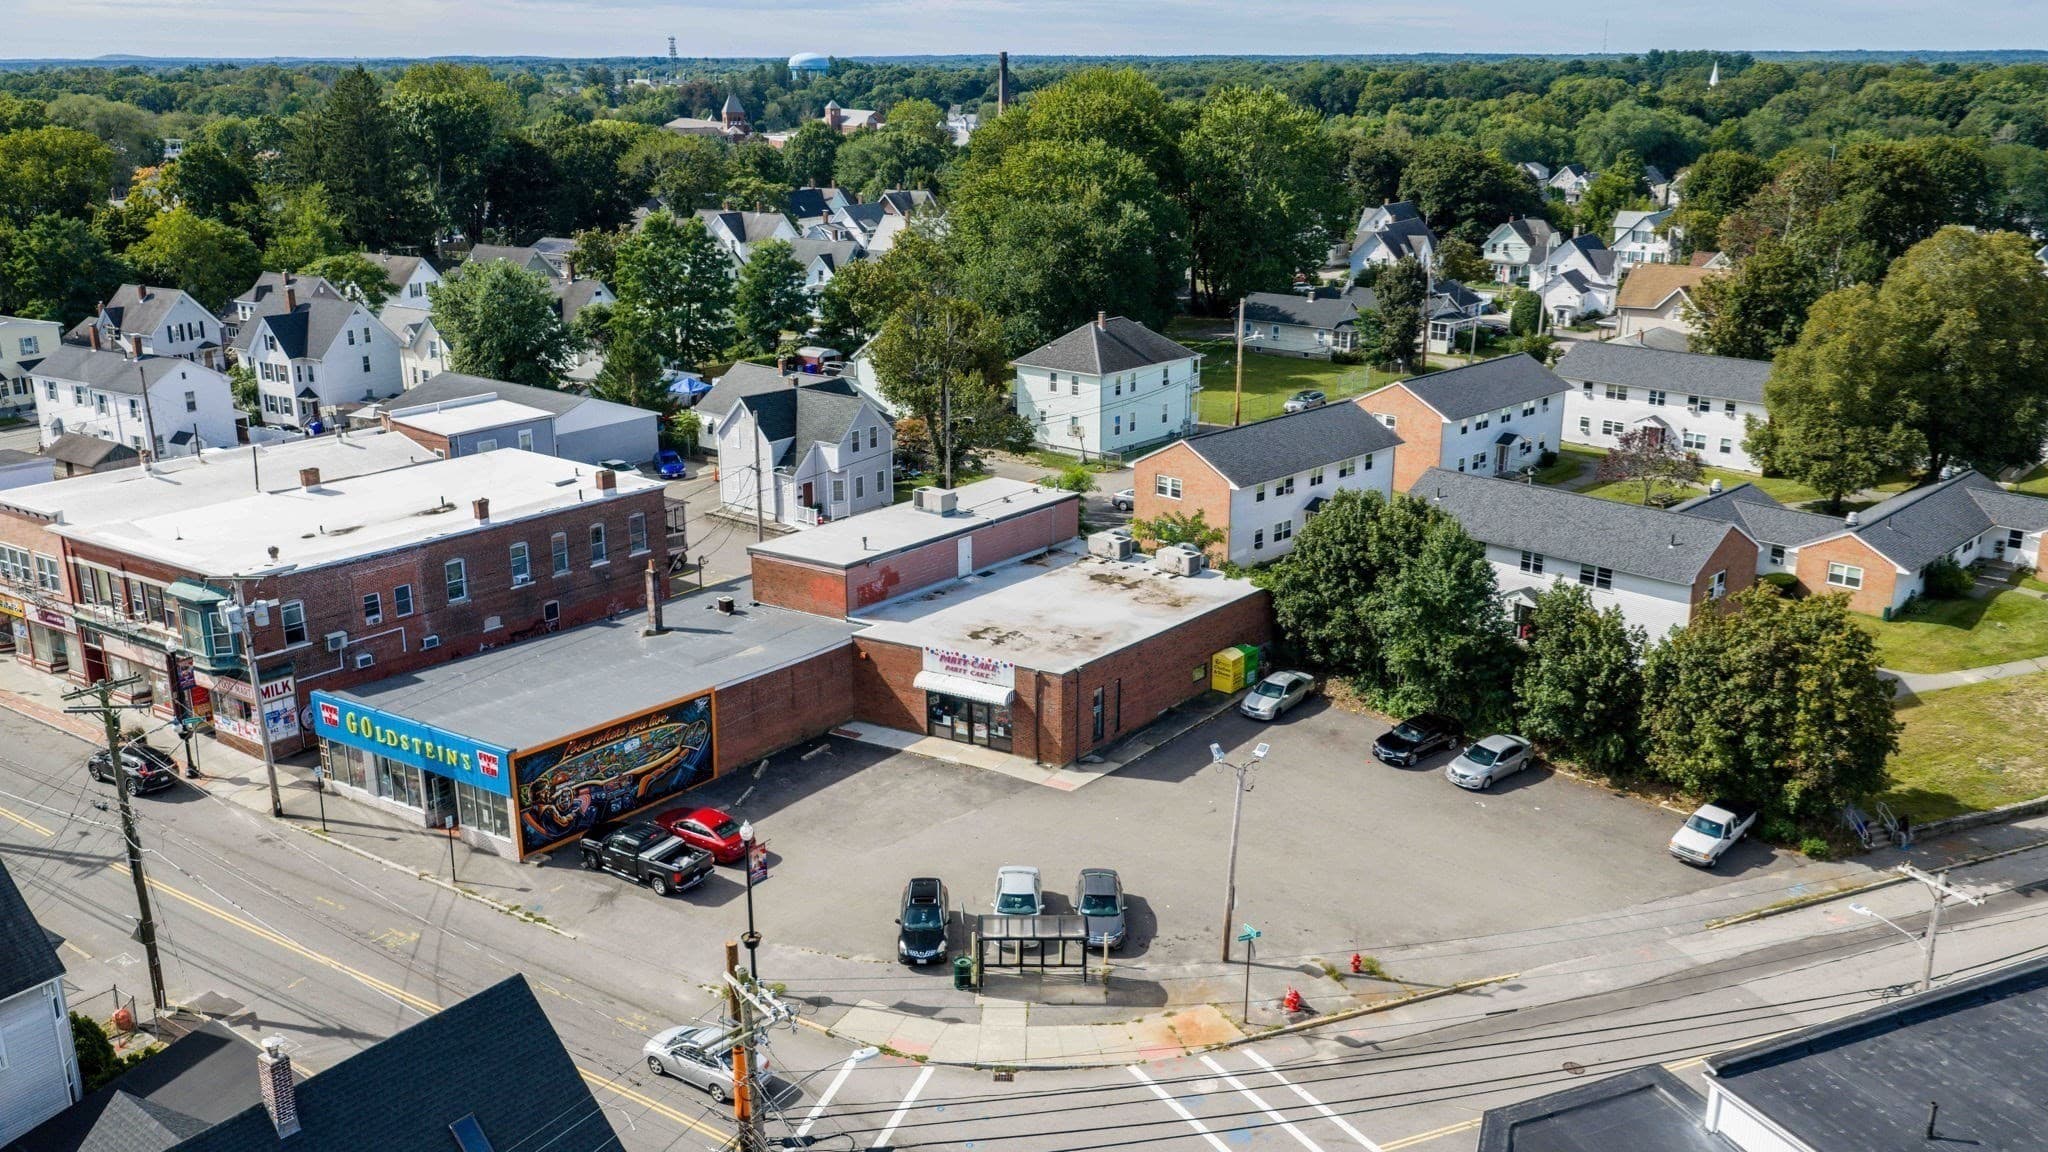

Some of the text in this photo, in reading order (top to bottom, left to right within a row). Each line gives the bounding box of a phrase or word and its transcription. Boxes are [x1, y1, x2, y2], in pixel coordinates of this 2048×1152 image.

[939, 654, 998, 673] PARTY CAKE
[945, 665, 990, 679] PARTY CAKE
[261, 679, 292, 699] MILK
[321, 703, 338, 716] FIVE
[627, 721, 648, 738] you
[648, 714, 669, 728] live
[346, 711, 472, 771] GOLDSTEIN'S
[478, 751, 498, 765] FIVE
[481, 764, 497, 777] TEN
